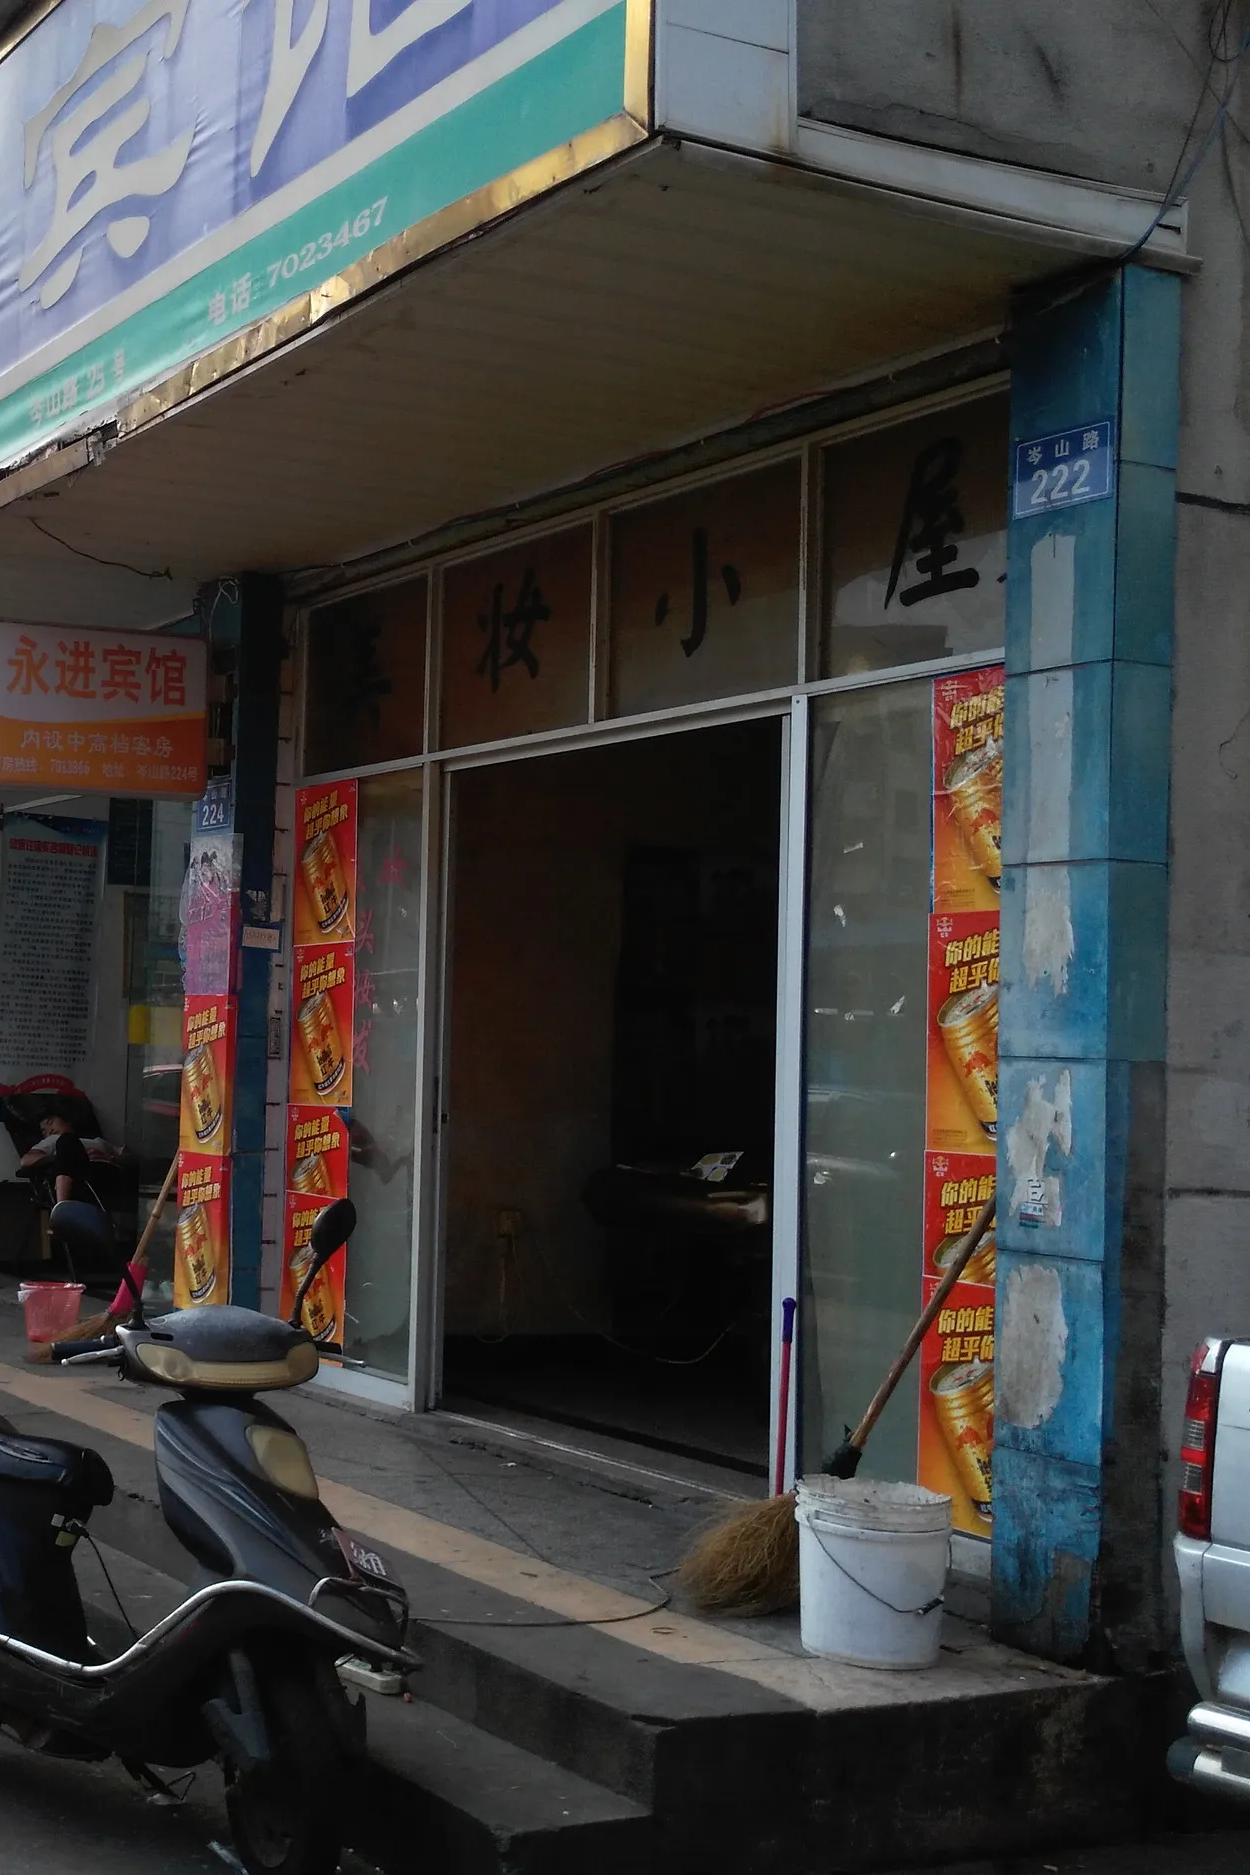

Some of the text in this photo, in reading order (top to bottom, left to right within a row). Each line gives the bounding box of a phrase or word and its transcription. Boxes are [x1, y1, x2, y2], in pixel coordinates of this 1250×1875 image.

[267, 195, 388, 288] 7023467
[1027, 429, 1100, 465] 岑山路
[1030, 459, 1091, 505] 222
[5, 633, 187, 707] 永进宾馆
[19, 729, 174, 759] 内设中高档客房
[202, 803, 224, 826] 224
[938, 1305, 1000, 1335] 你的能
